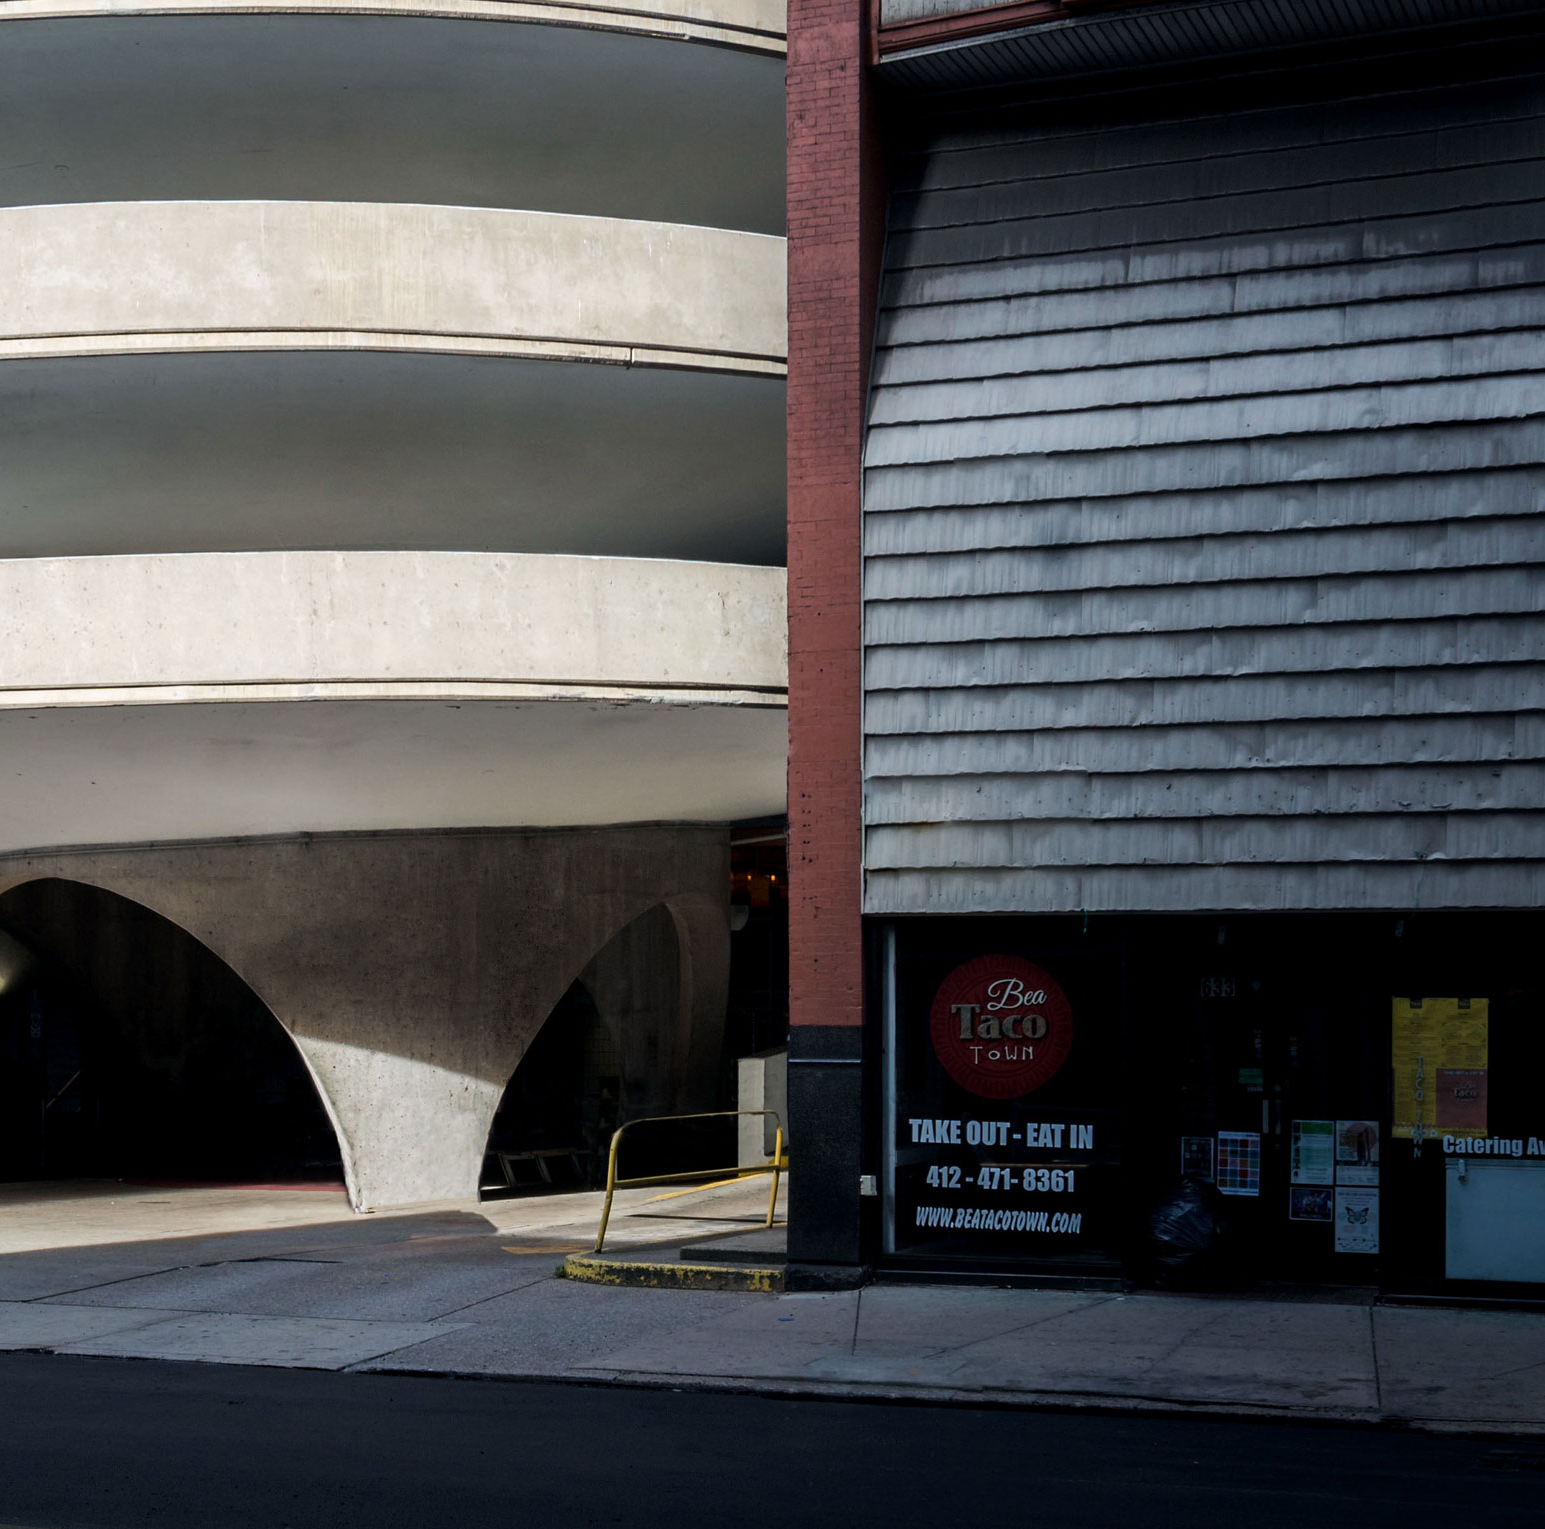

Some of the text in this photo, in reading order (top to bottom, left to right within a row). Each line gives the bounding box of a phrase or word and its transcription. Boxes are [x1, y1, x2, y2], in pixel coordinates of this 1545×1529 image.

[987, 977, 1047, 1011] Bea
[951, 1003, 1048, 1039] Taco
[908, 1118, 962, 1145] TAKE
[966, 1120, 1011, 1146] OUT
[1026, 1122, 1066, 1149] EAT
[1070, 1124, 1094, 1150] IN
[1443, 1134, 1523, 1157] Catering
[926, 1165, 962, 1189] 412
[1022, 1169, 1075, 1193] 8361
[915, 1206, 1082, 1235] WWW.BEATACOTOWN.COM
